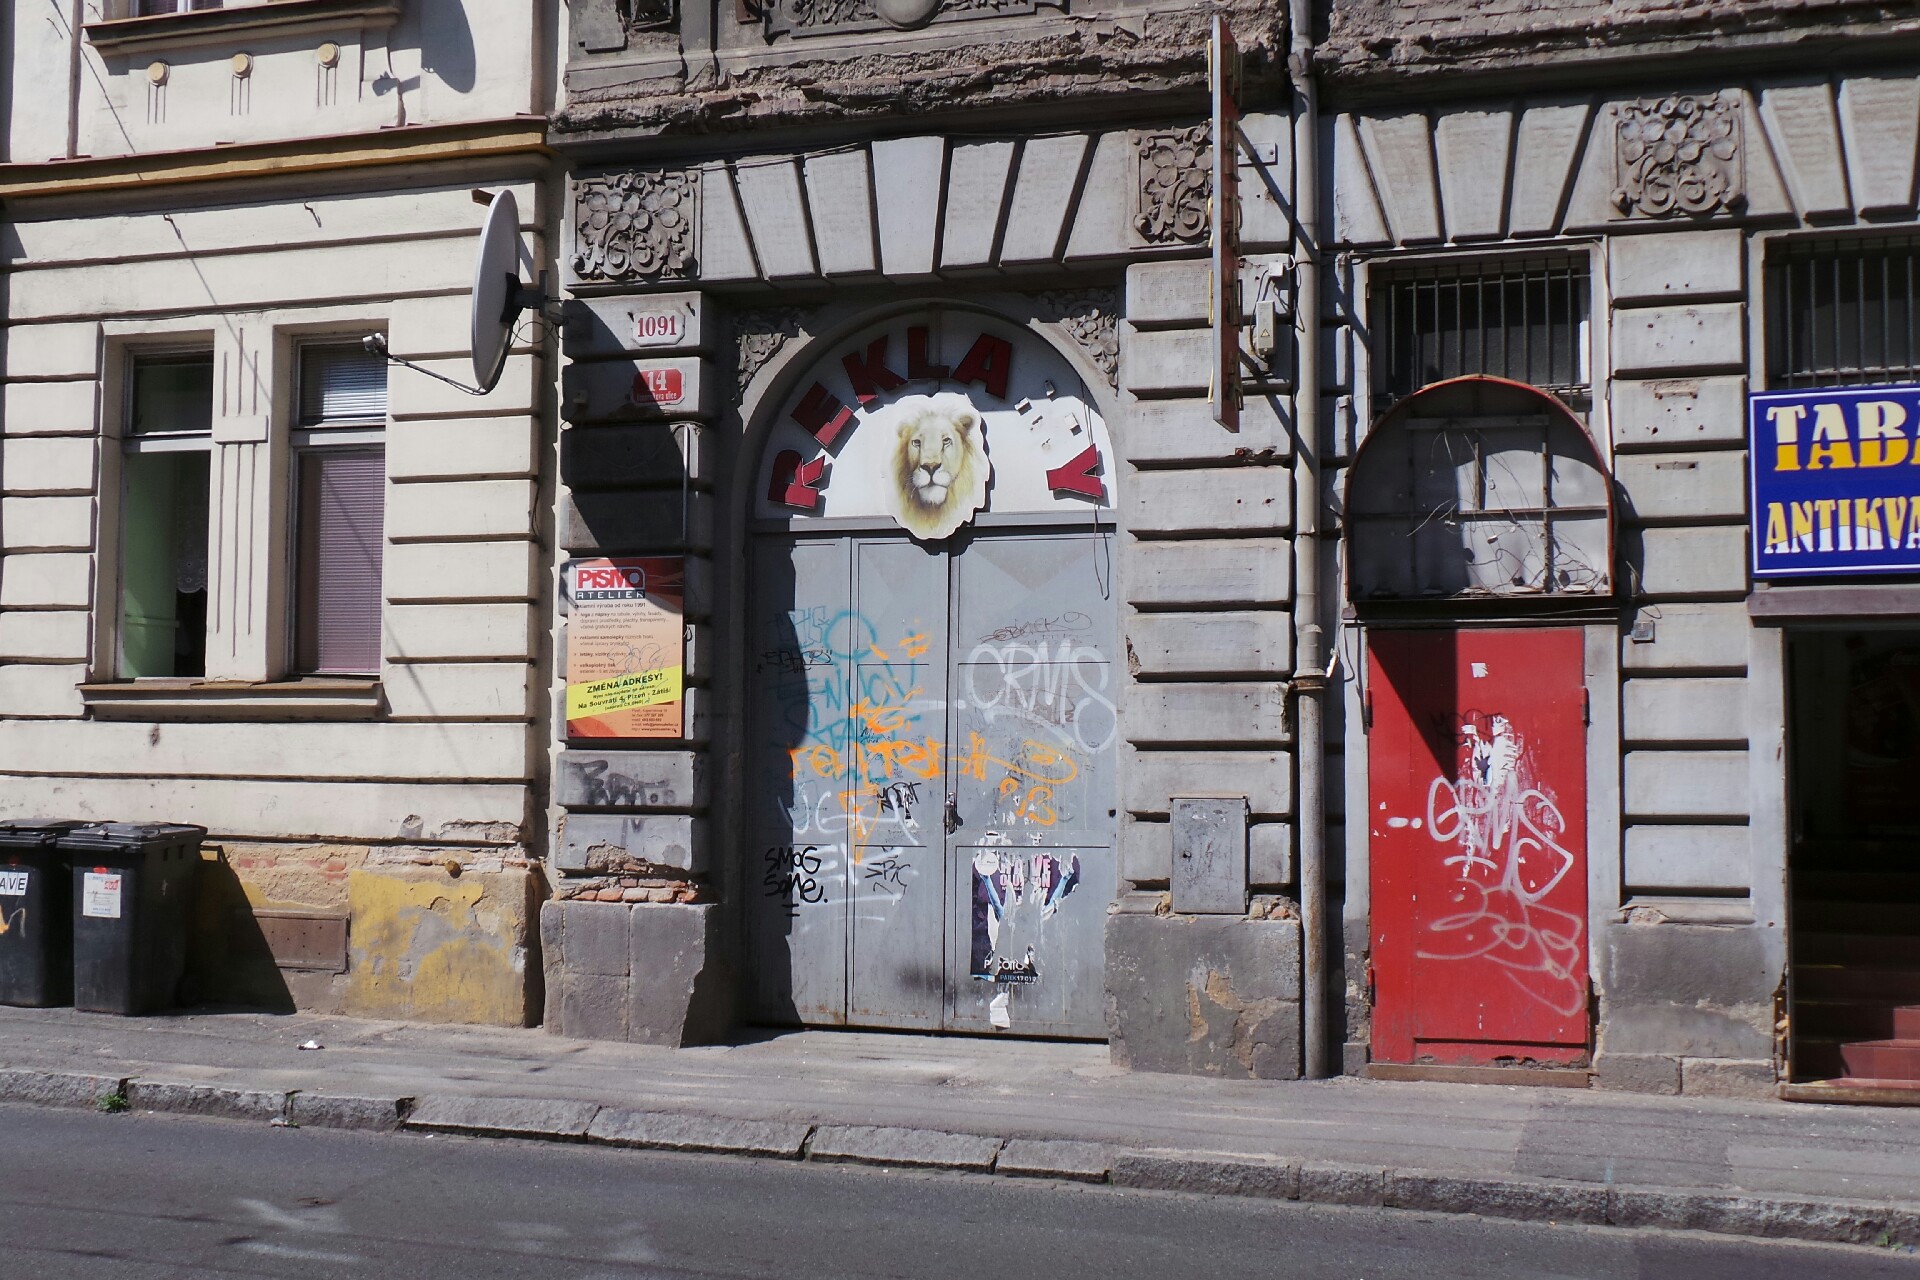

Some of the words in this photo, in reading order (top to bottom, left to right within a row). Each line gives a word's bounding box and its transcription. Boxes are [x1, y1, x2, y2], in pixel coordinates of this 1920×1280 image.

[638, 315, 677, 338] 1091
[647, 370, 668, 392] 14
[1766, 400, 1920, 471] TAB
[577, 591, 644, 599] ATELIER
[587, 681, 620, 694] ZMĚNA
[622, 673, 663, 687] ADRESY!
